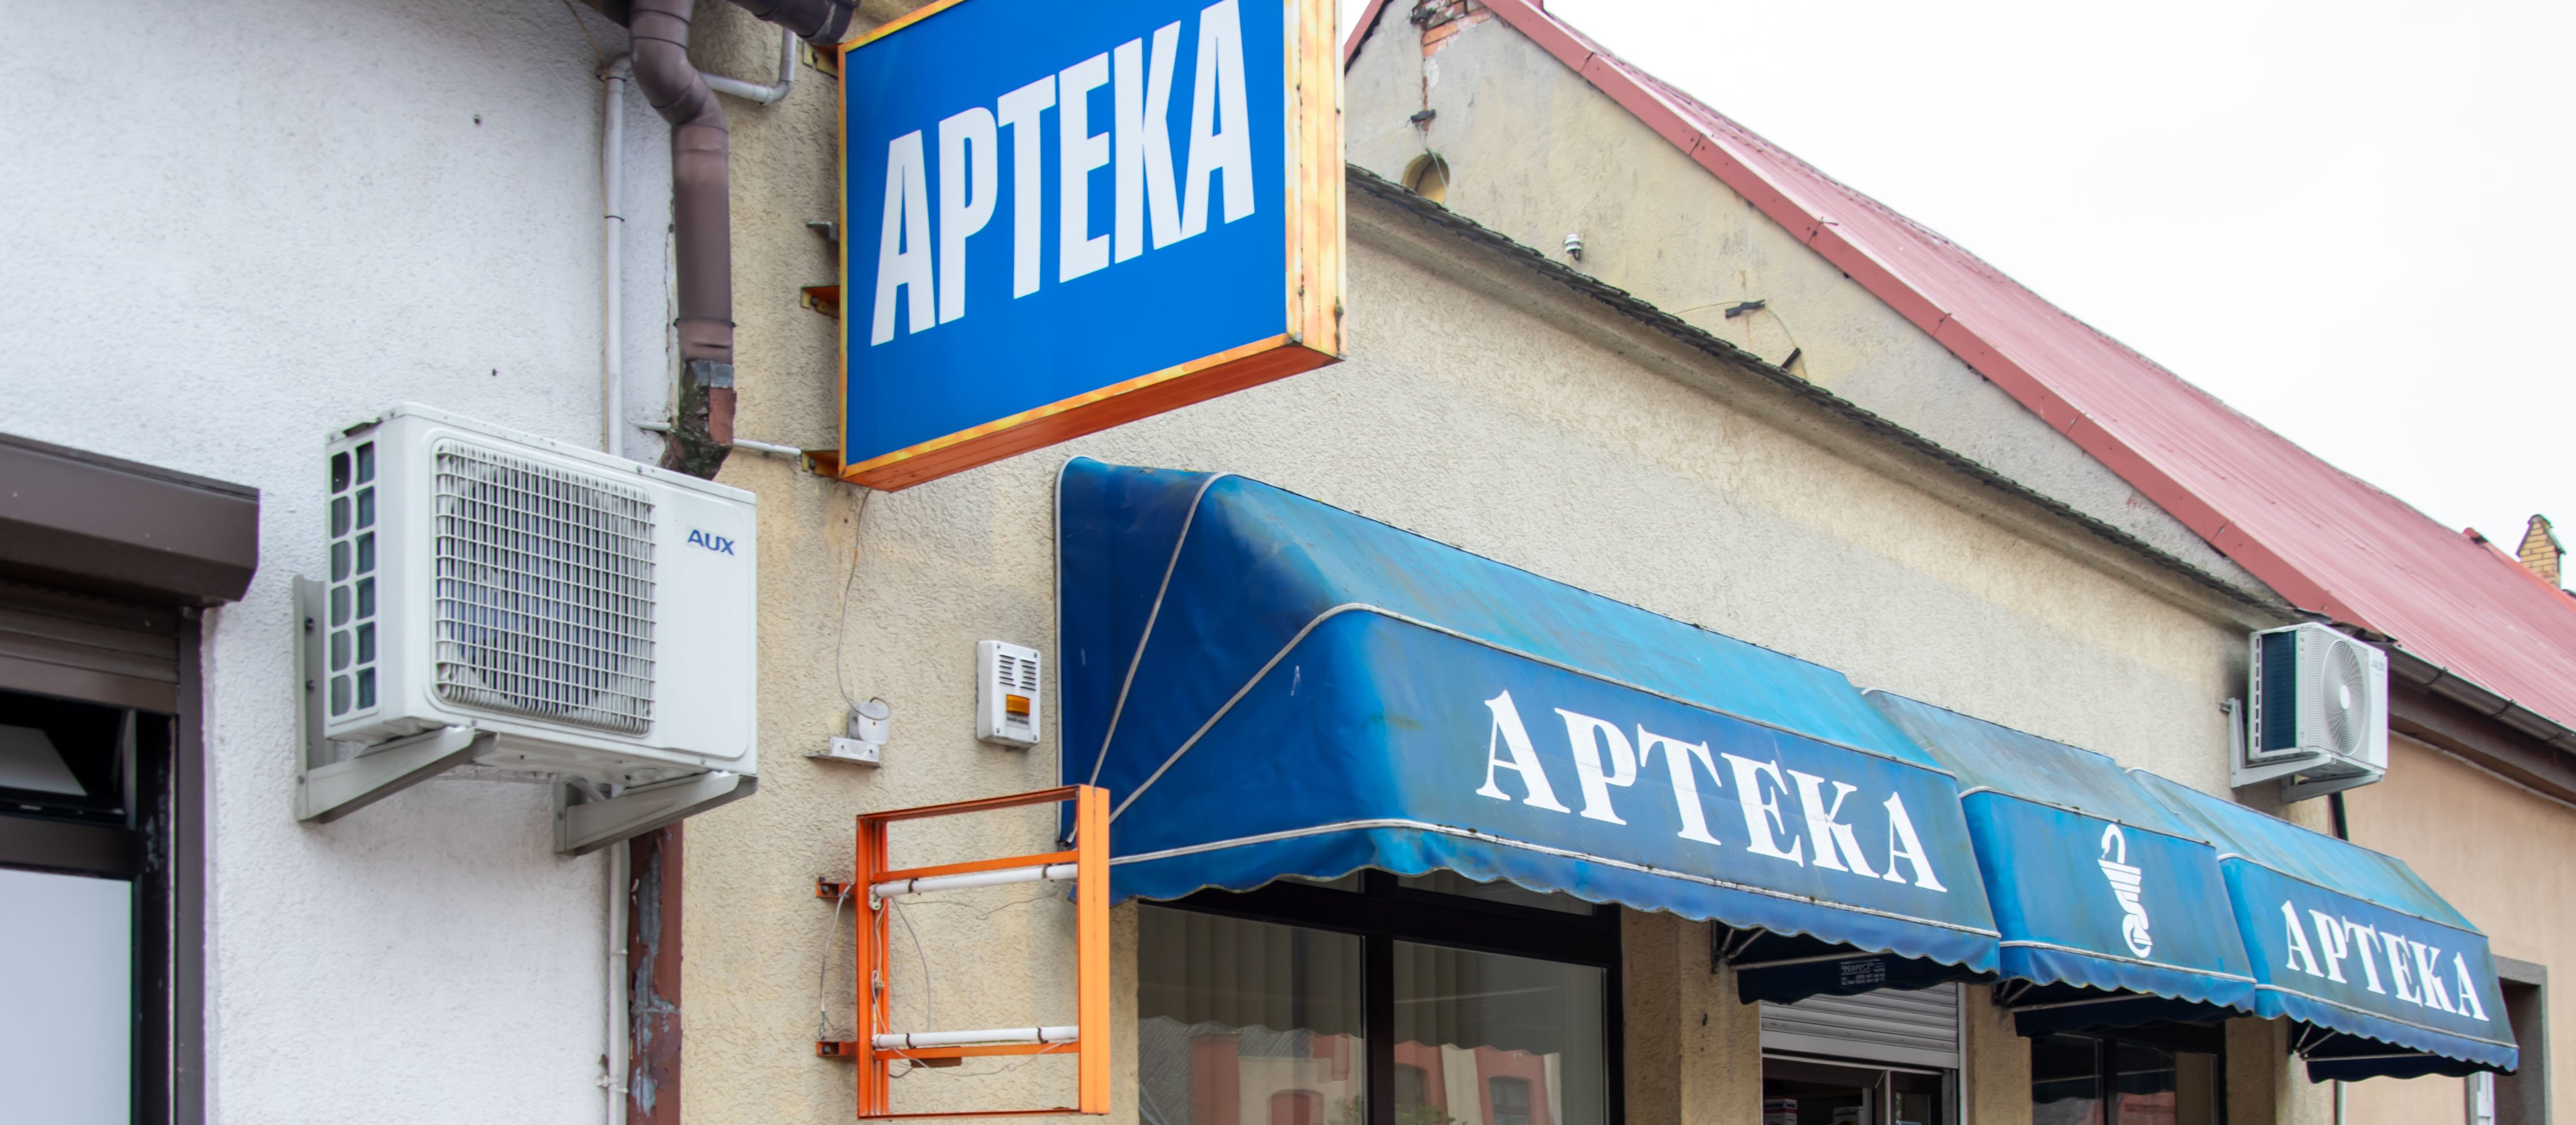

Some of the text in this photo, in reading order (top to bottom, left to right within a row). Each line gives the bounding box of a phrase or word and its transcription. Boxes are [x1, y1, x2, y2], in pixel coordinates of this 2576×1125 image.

[871, 0, 1255, 347] APTEKA
[688, 529, 735, 556] AUX
[1476, 690, 1947, 893] APTEKA
[2281, 900, 2490, 1021] APTEKA
